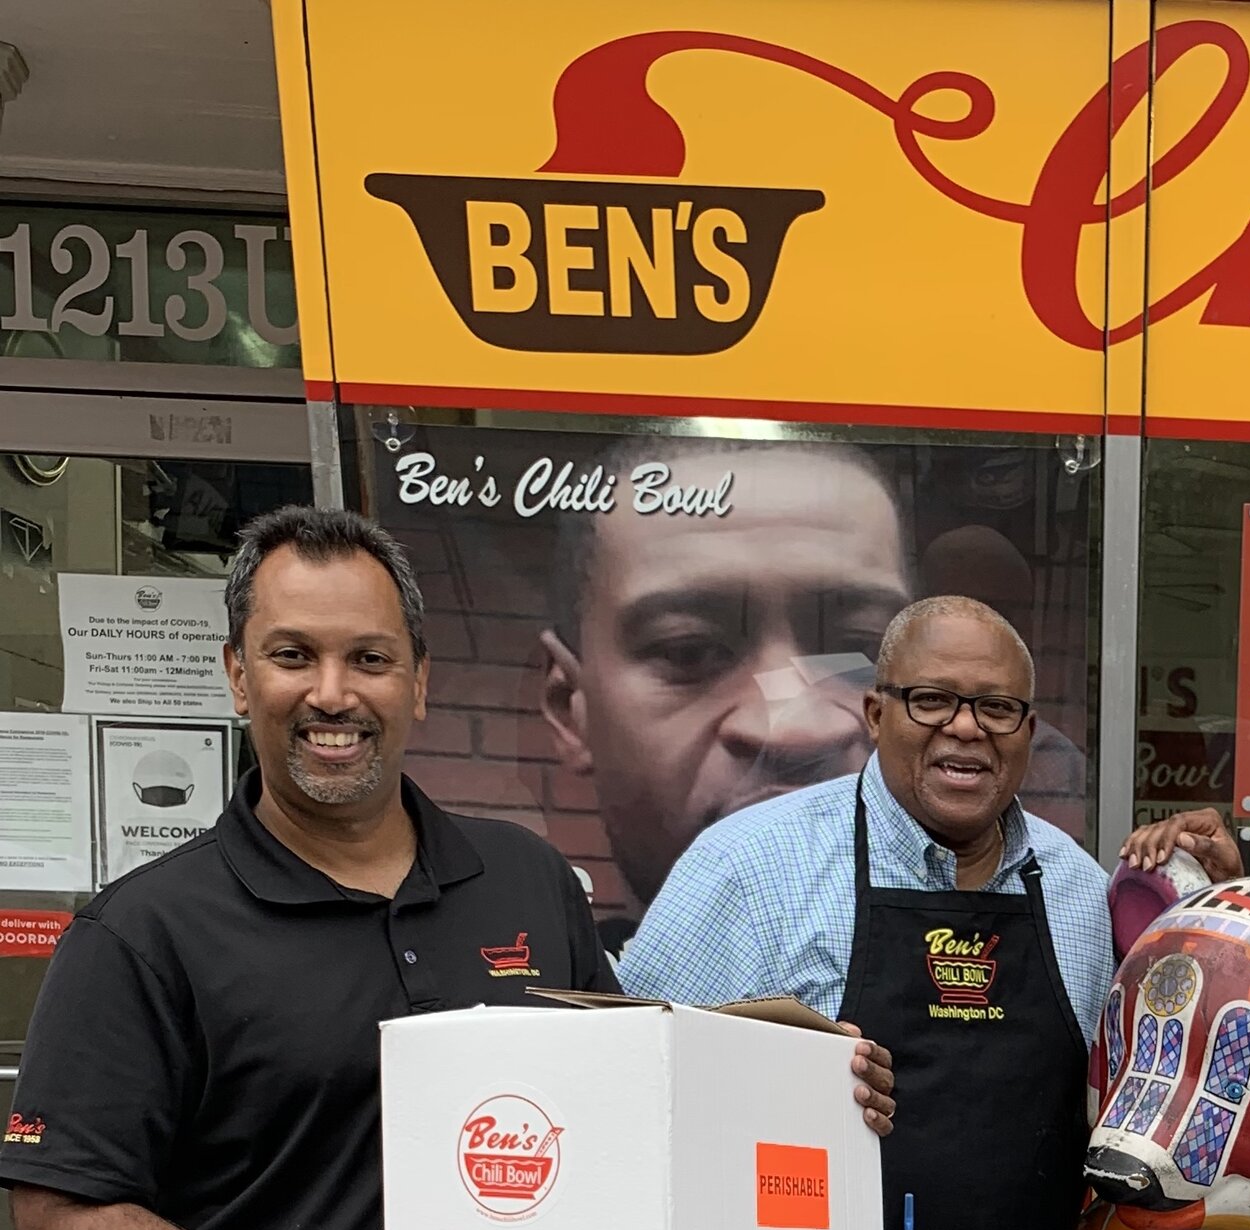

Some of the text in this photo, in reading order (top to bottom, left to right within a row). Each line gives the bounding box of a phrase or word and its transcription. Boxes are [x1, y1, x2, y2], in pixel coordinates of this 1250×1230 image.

[465, 200, 751, 323] BEN'S
[0, 222, 228, 342] 1213
[395, 452, 735, 518] Ben's Chili Bowl
[88, 616, 105, 625] Due
[106, 616, 116, 625] to
[116, 616, 130, 625] the
[131, 617, 159, 627] impact
[160, 618, 169, 626] of
[67, 627, 88, 638] Our
[91, 628, 124, 639] DAILY
[126, 629, 166, 640] HOURS
[168, 631, 180, 641] of
[85, 651, 132, 662] Sun-Thurs
[134, 653, 157, 662] 11:00
[159, 654, 174, 663] AM
[181, 654, 200, 664] 7:00
[202, 655, 216, 664] PM
[89, 664, 119, 673] Fri-Sat
[121, 665, 157, 675] 11:00am
[165, 666, 214, 677] 12Midnight
[1, 918, 61, 931] deliver with
[0, 932, 61, 946] OORDA
[924, 928, 984, 956] Ben's
[934, 966, 989, 983] CHILI BOWL
[928, 1003, 1004, 1021] Washington DC
[464, 1115, 538, 1151] Ben's
[471, 1163, 542, 1185] Chili Bowl
[759, 1174, 825, 1198] PERISHABLE
